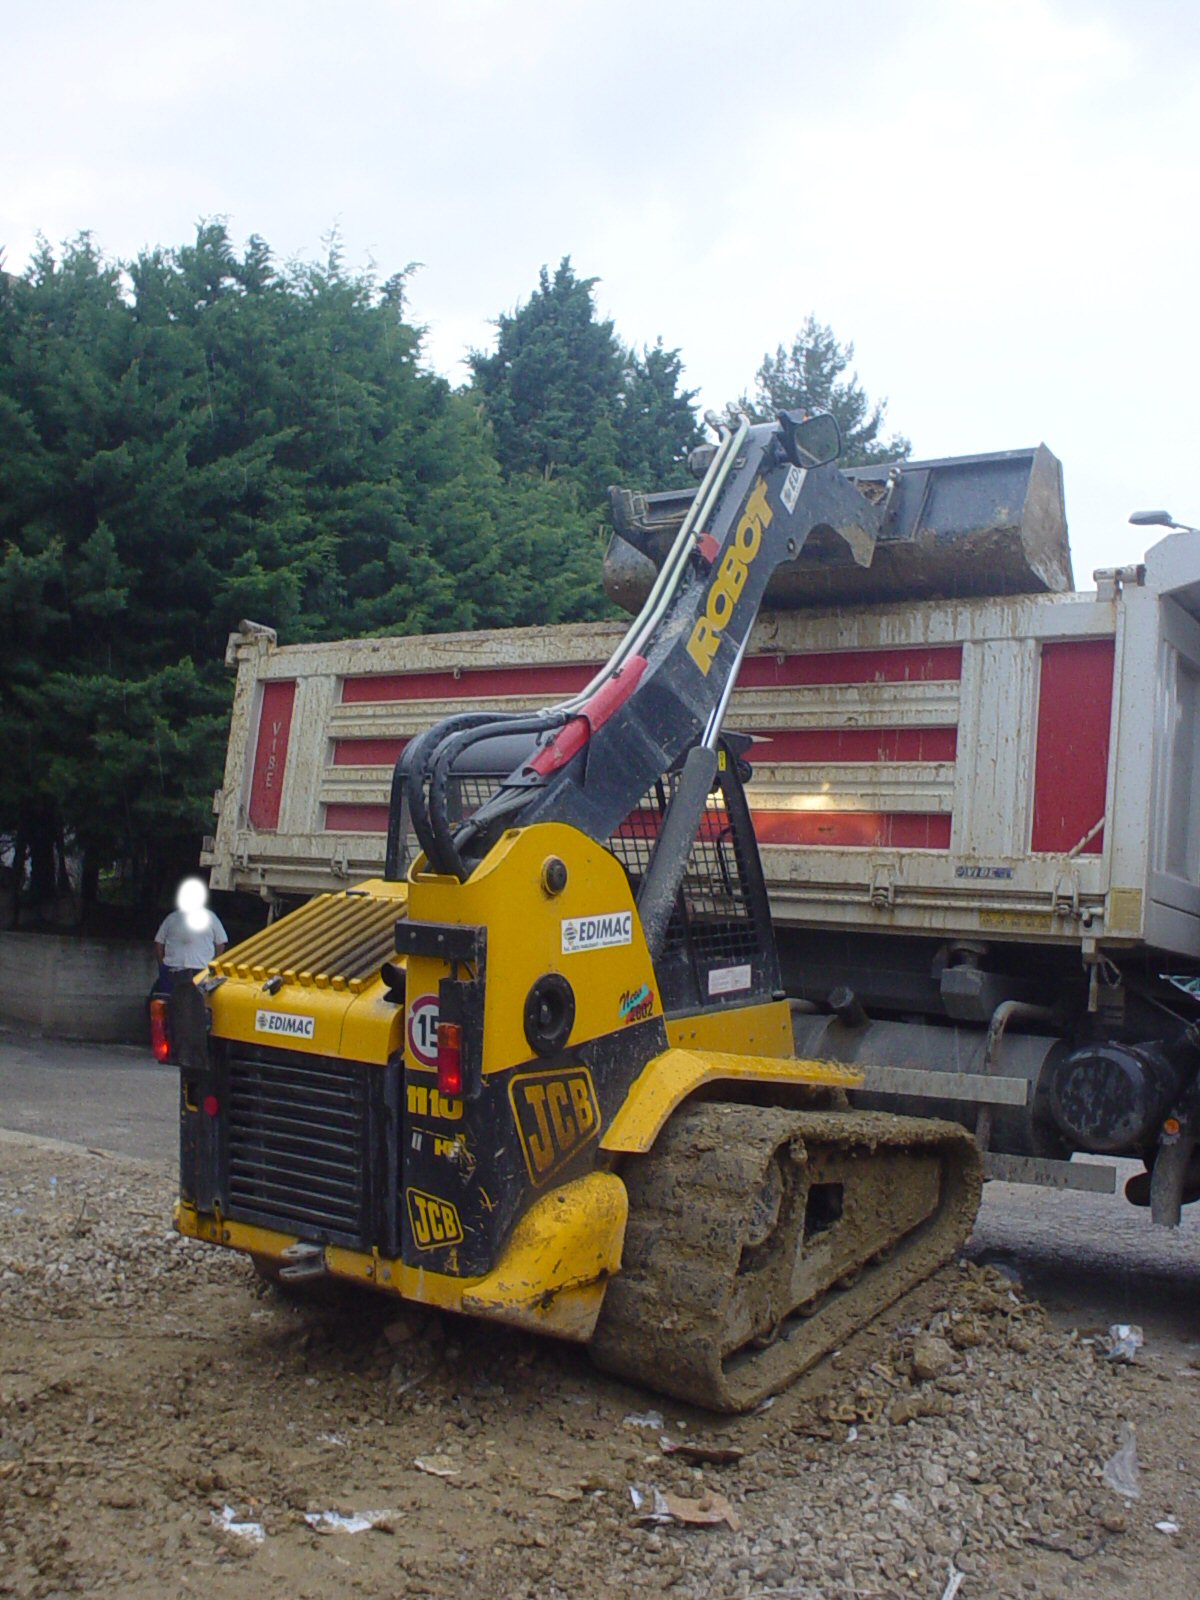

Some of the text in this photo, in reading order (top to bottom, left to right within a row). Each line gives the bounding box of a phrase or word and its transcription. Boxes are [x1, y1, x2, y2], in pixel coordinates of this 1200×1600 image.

[686, 475, 774, 677] ROBOT
[578, 915, 631, 942] EDIMAC
[268, 1015, 313, 1035] EDIMAC
[406, 1084, 464, 1120] 1110
[524, 1079, 593, 1172] JCB
[414, 1194, 458, 1243] JCB
